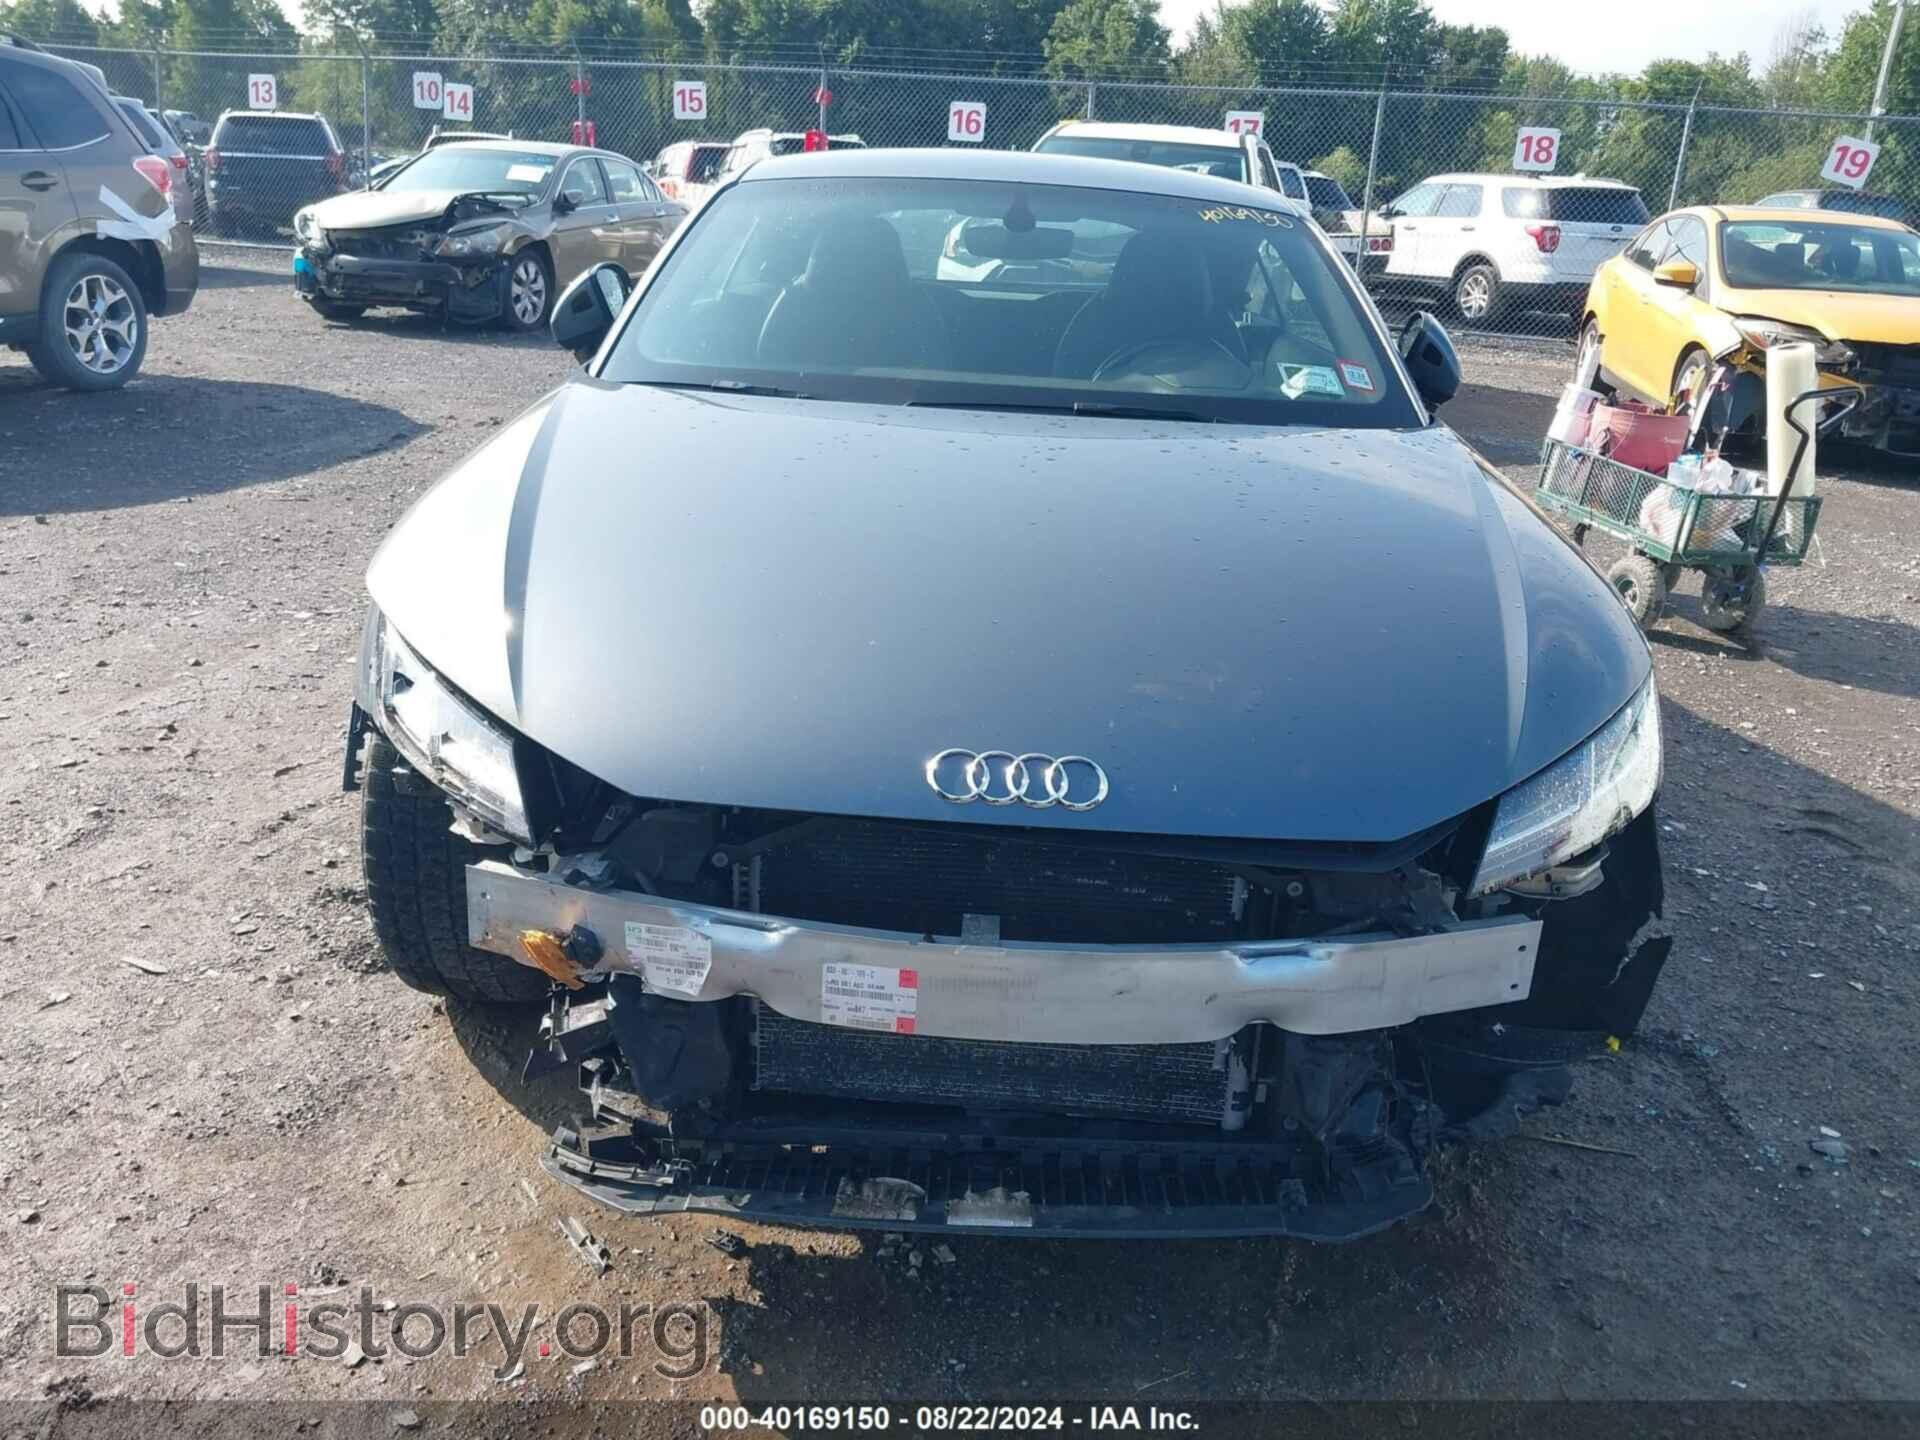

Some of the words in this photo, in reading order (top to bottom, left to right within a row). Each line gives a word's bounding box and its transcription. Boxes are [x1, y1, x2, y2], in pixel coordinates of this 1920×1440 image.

[250, 80, 273, 104] 13
[416, 80, 440, 102] 10
[446, 90, 470, 115] 14
[676, 88, 704, 113] 15
[952, 109, 982, 135] 16
[1519, 134, 1555, 164] 18
[1832, 144, 1871, 179] 19
